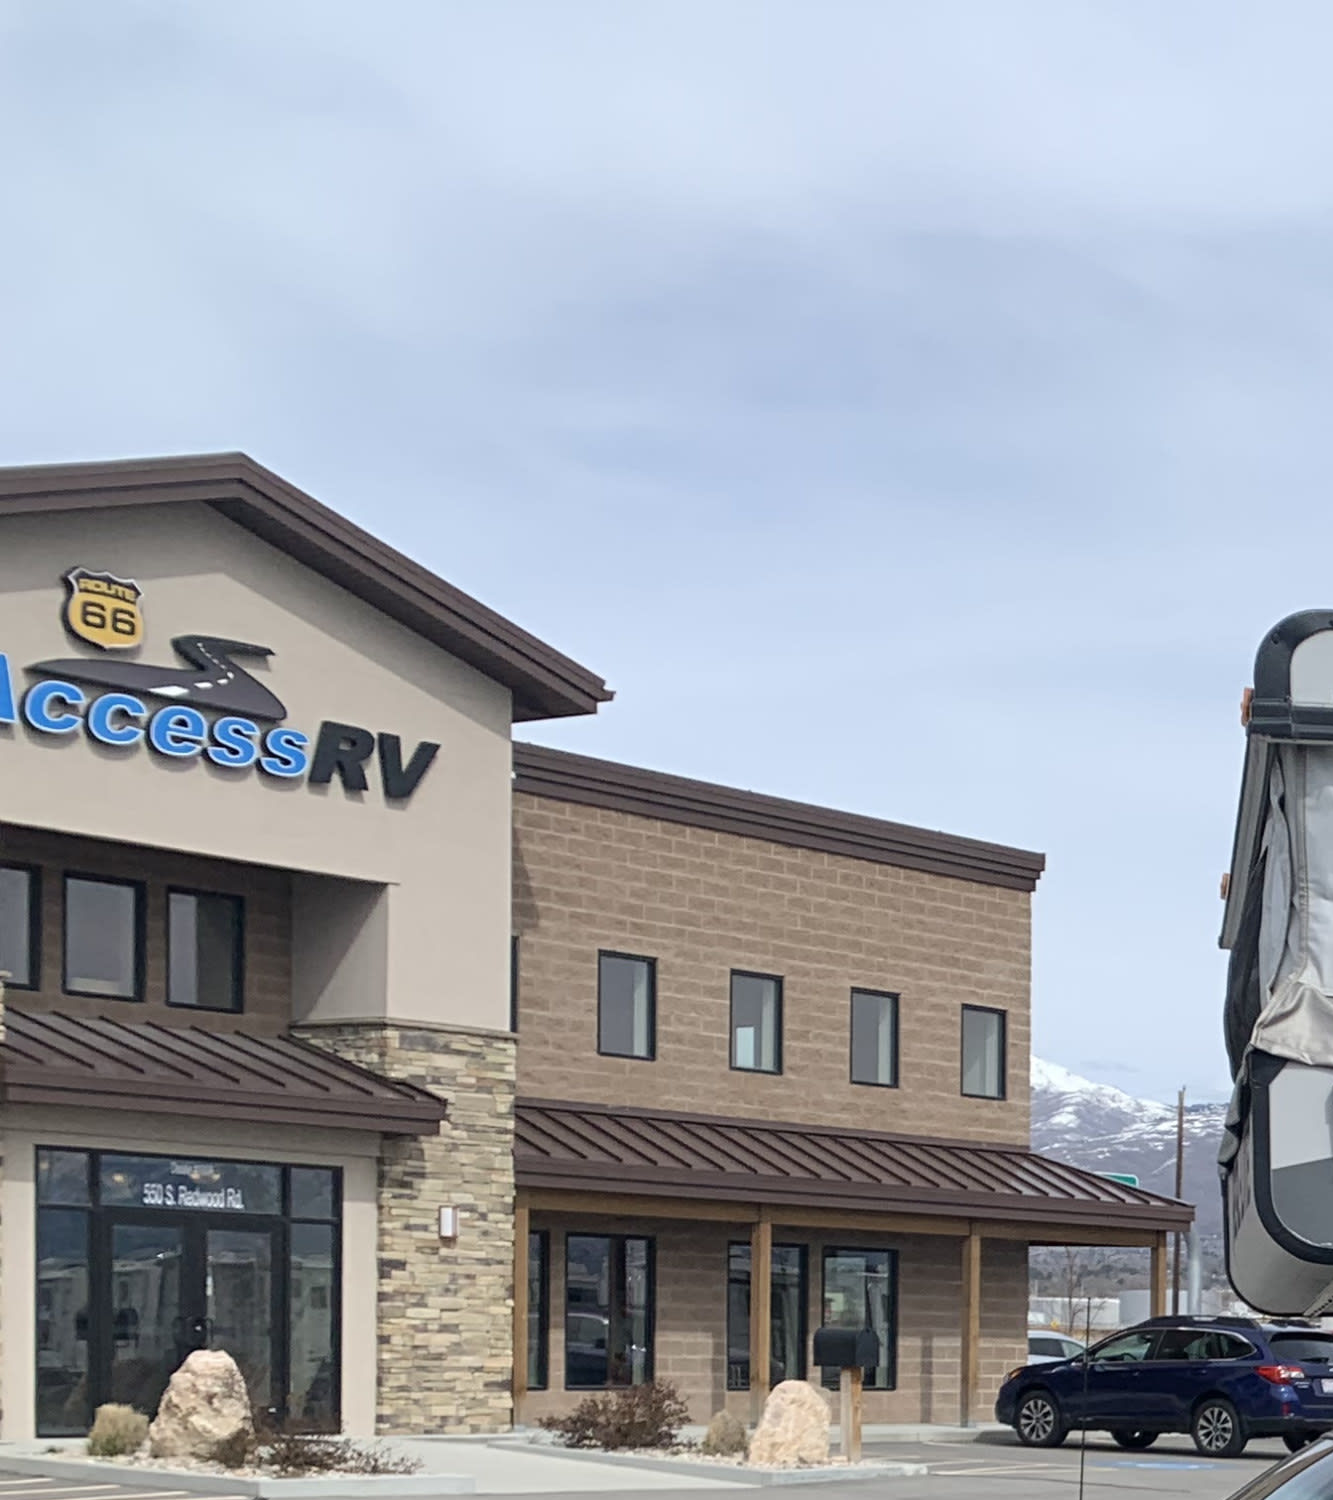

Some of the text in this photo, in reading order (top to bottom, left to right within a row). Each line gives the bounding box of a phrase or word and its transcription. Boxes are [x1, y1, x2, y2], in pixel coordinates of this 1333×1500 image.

[82, 601, 136, 636] 66
[0, 652, 441, 799] ccessRV
[178, 1185, 225, 1208] Redwood
